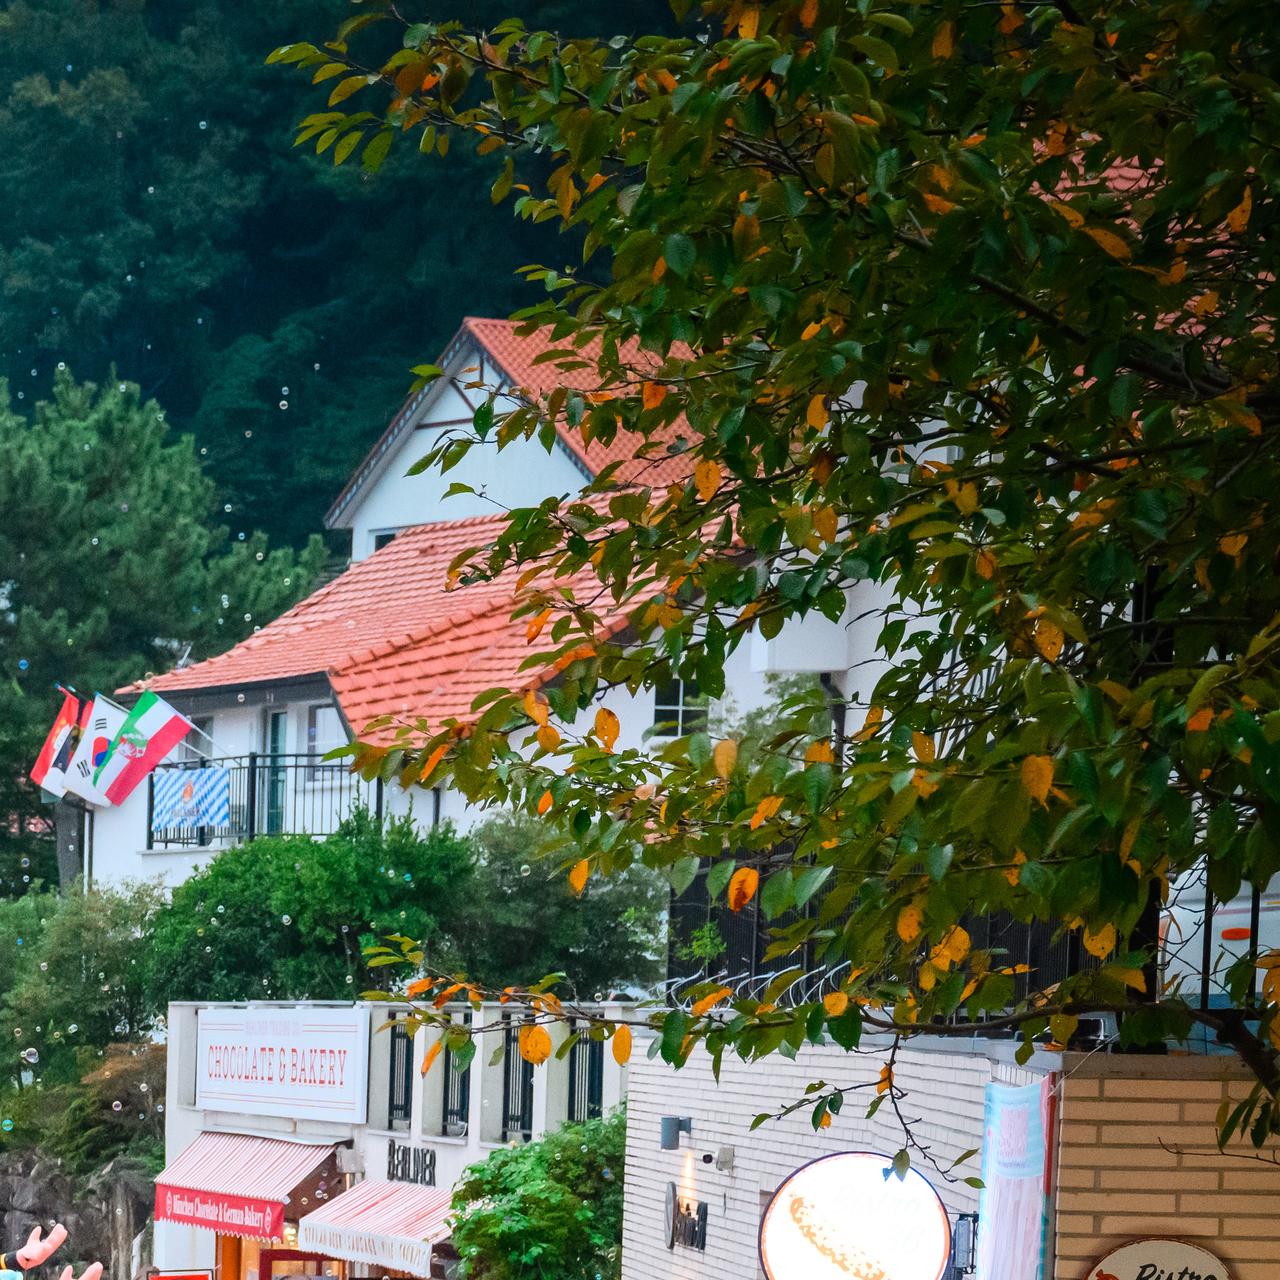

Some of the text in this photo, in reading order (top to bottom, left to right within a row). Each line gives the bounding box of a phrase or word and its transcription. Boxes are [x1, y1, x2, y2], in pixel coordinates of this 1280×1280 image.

[208, 1046, 274, 1081] CHOCOLATE
[291, 1049, 347, 1085] BAKERY
[387, 1138, 436, 1187] BERLINER
